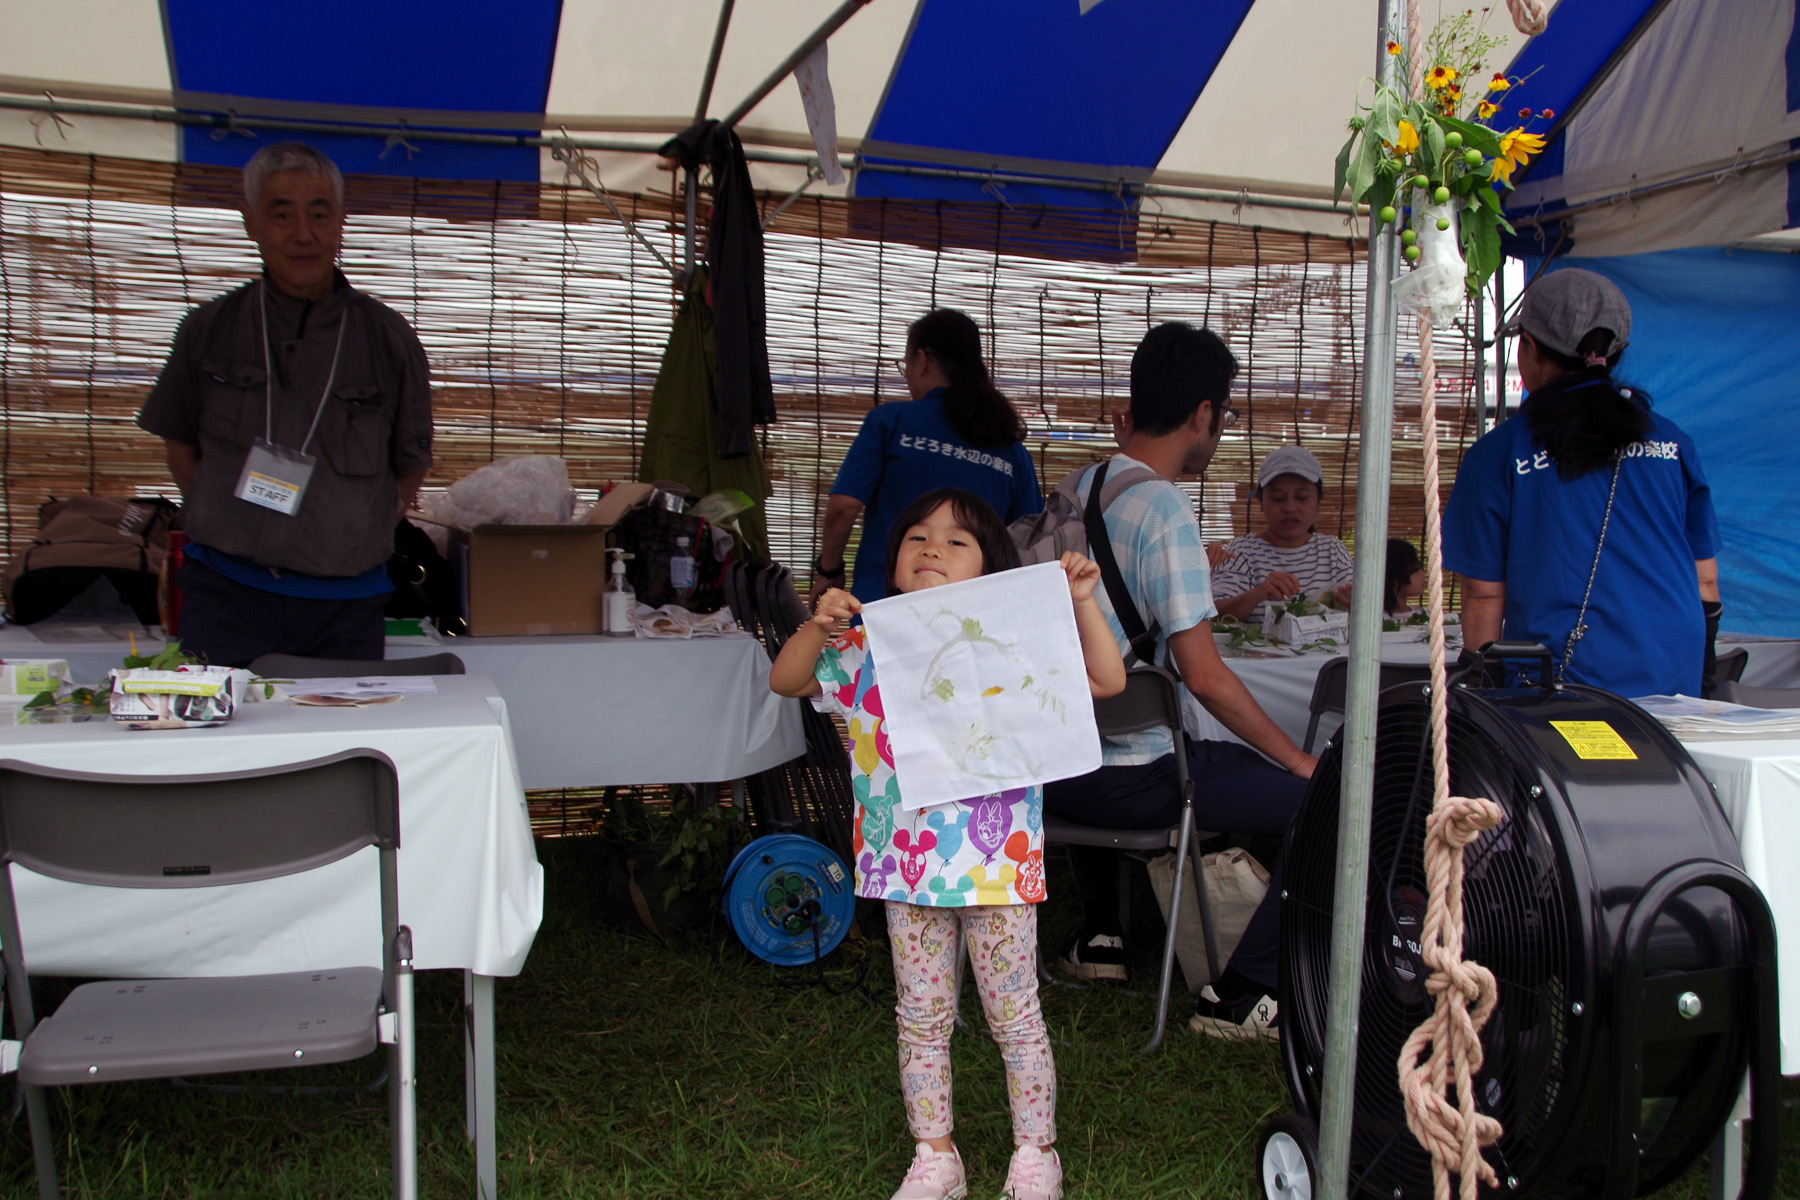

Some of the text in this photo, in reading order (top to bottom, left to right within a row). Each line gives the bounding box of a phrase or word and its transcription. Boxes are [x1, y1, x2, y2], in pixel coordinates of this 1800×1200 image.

[899, 433, 1014, 477] とどろき水辺の楽校
[249, 485, 289, 503] STAFF
